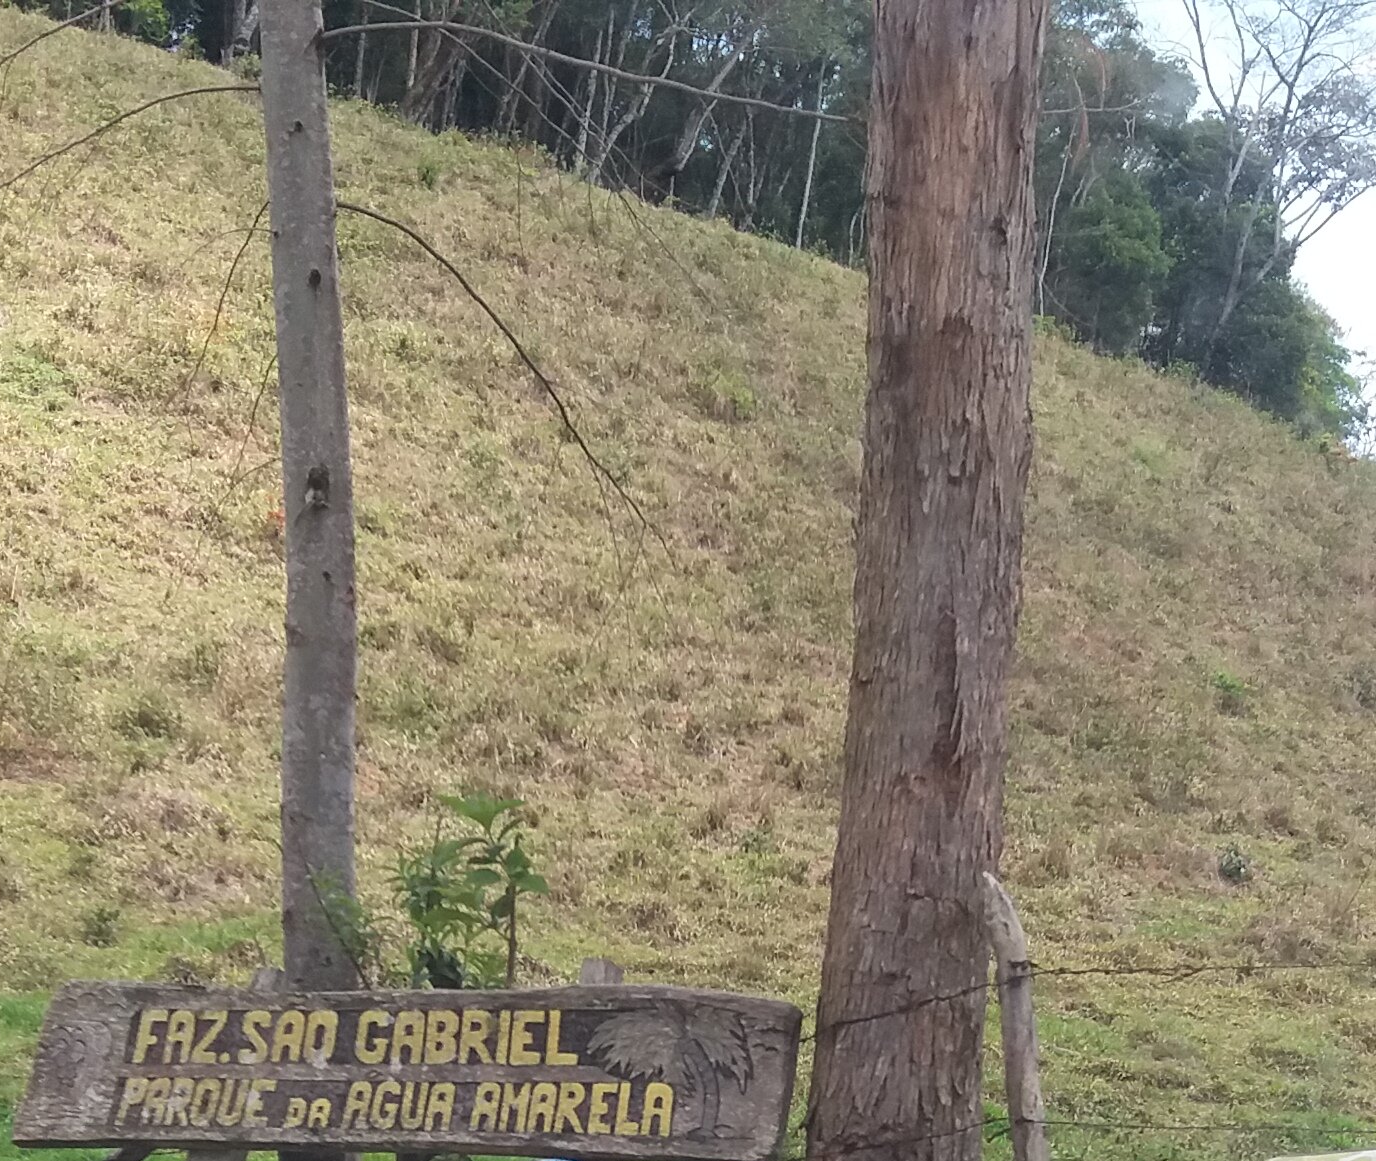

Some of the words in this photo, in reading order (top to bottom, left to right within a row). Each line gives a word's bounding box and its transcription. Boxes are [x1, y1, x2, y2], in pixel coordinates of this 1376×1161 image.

[355, 1008, 579, 1067] GABRIEL
[114, 1077, 278, 1128] PARQUE
[340, 1080, 456, 1132] AGUA
[470, 1081, 674, 1138] AMARELA
